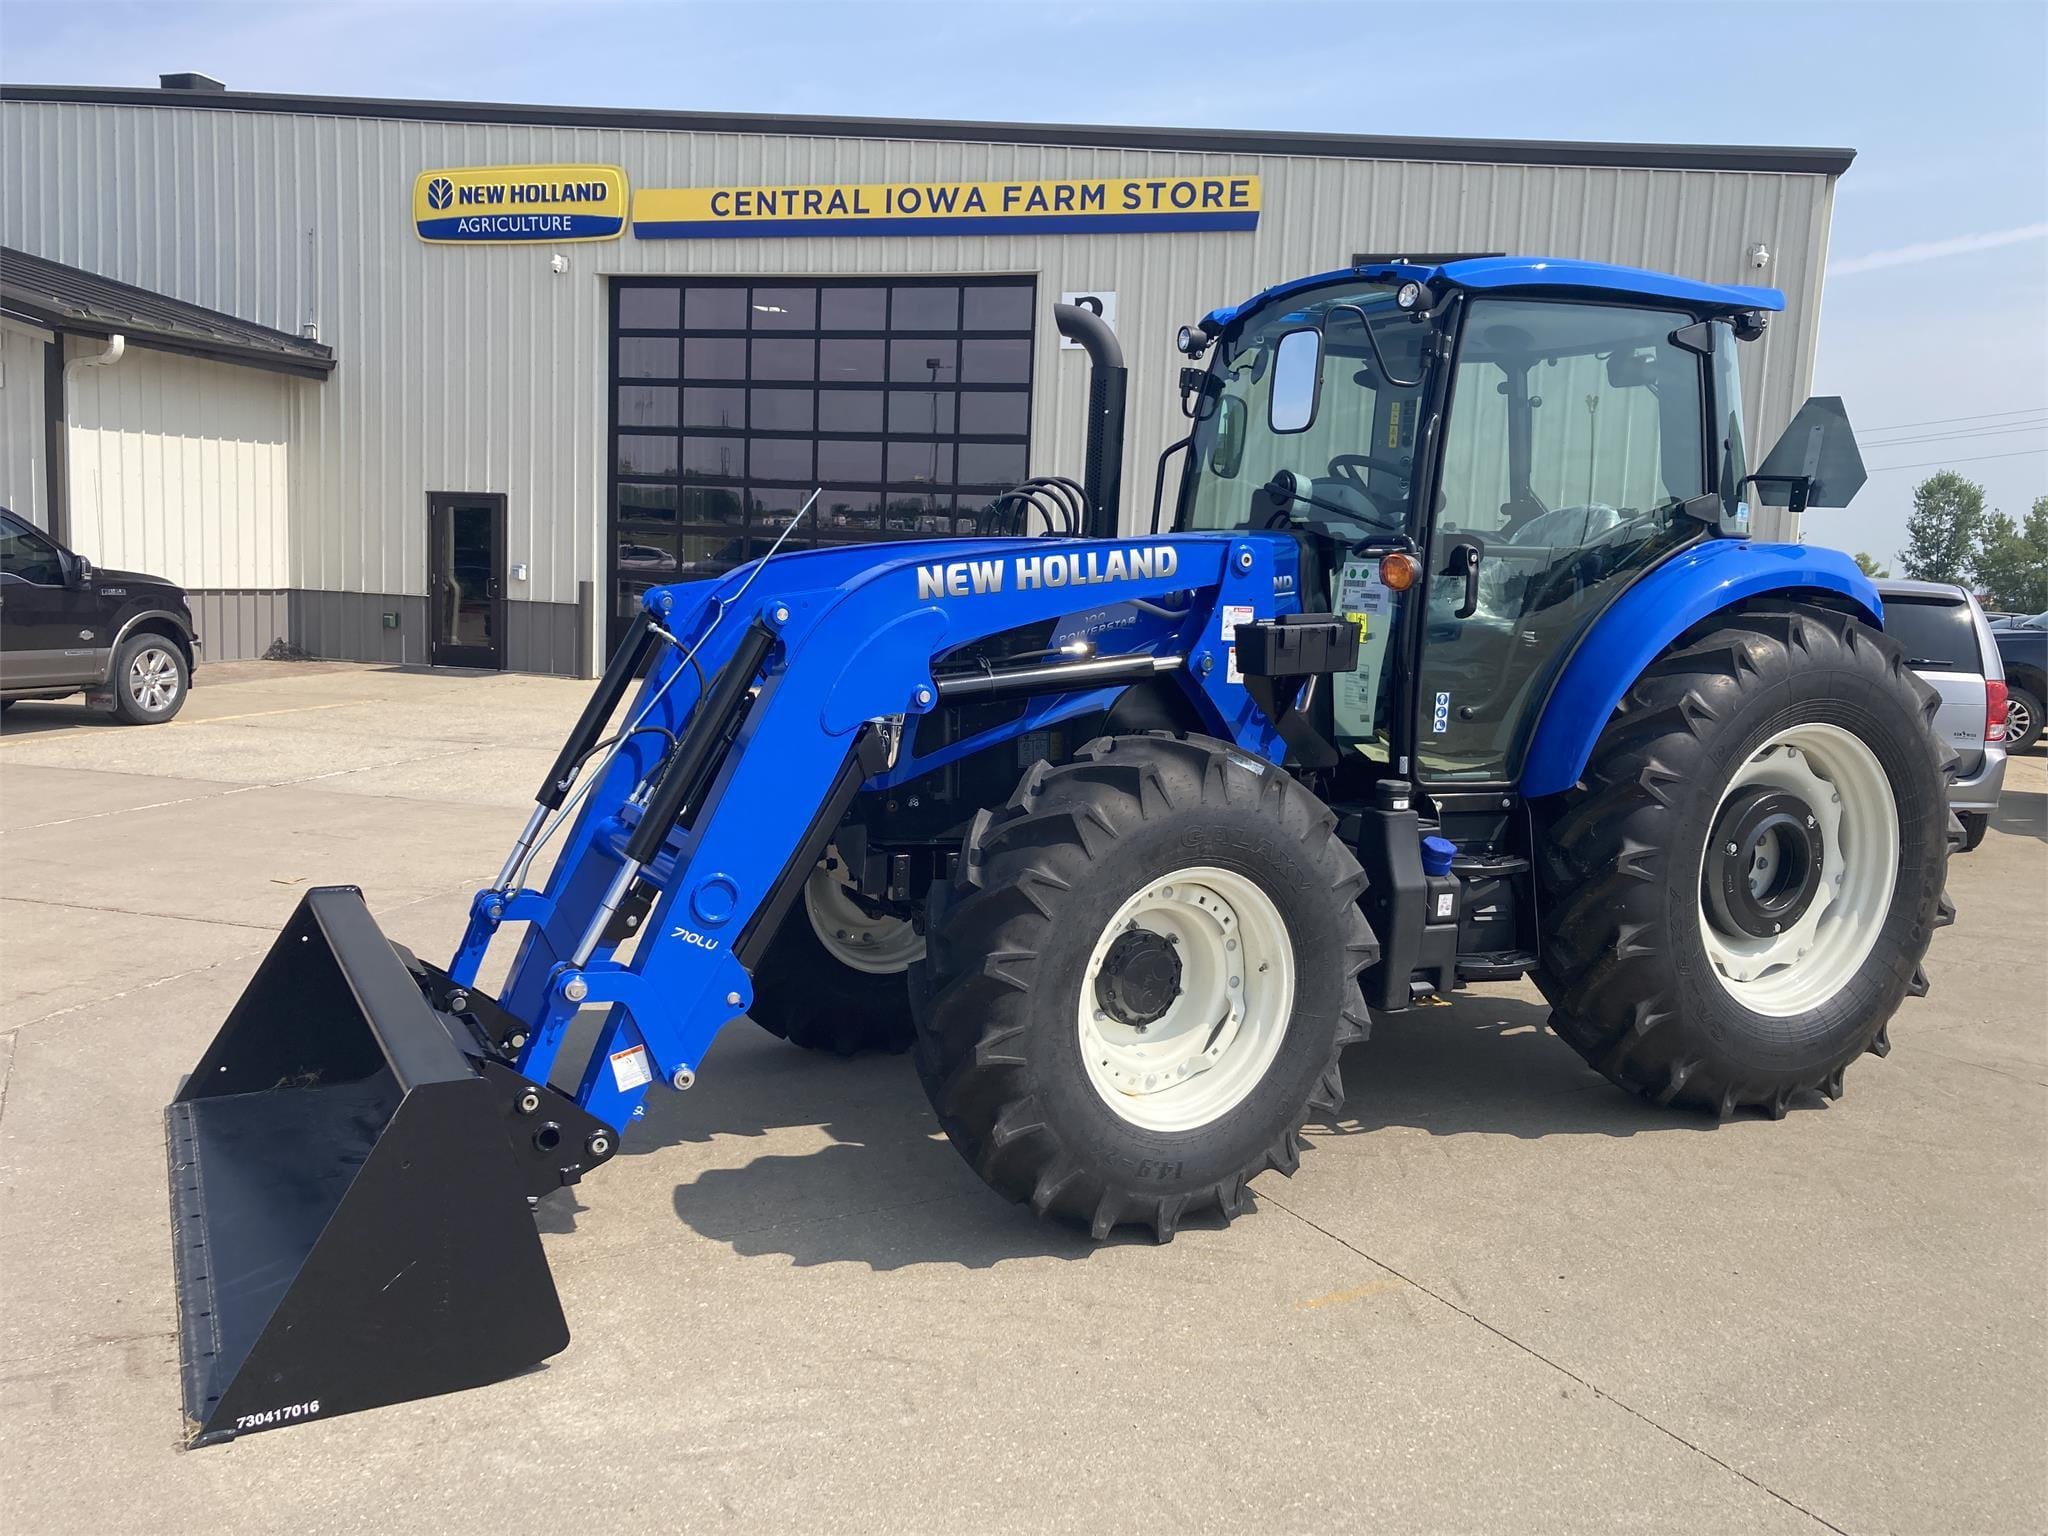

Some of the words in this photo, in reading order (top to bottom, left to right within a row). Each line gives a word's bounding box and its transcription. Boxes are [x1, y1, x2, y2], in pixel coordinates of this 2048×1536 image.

[459, 186, 505, 205] NEW
[511, 182, 607, 204] HOLLAND
[710, 188, 870, 217] CENTRAL
[885, 186, 987, 213] IOWA
[1003, 184, 1106, 211] FARM
[1122, 180, 1250, 209] STORE
[457, 216, 572, 233] AGRICULTURE
[916, 559, 1004, 600] NEW
[1015, 545, 1178, 591] HOLLAND
[671, 926, 719, 950] 710LU
[236, 1400, 320, 1429] 730417016
